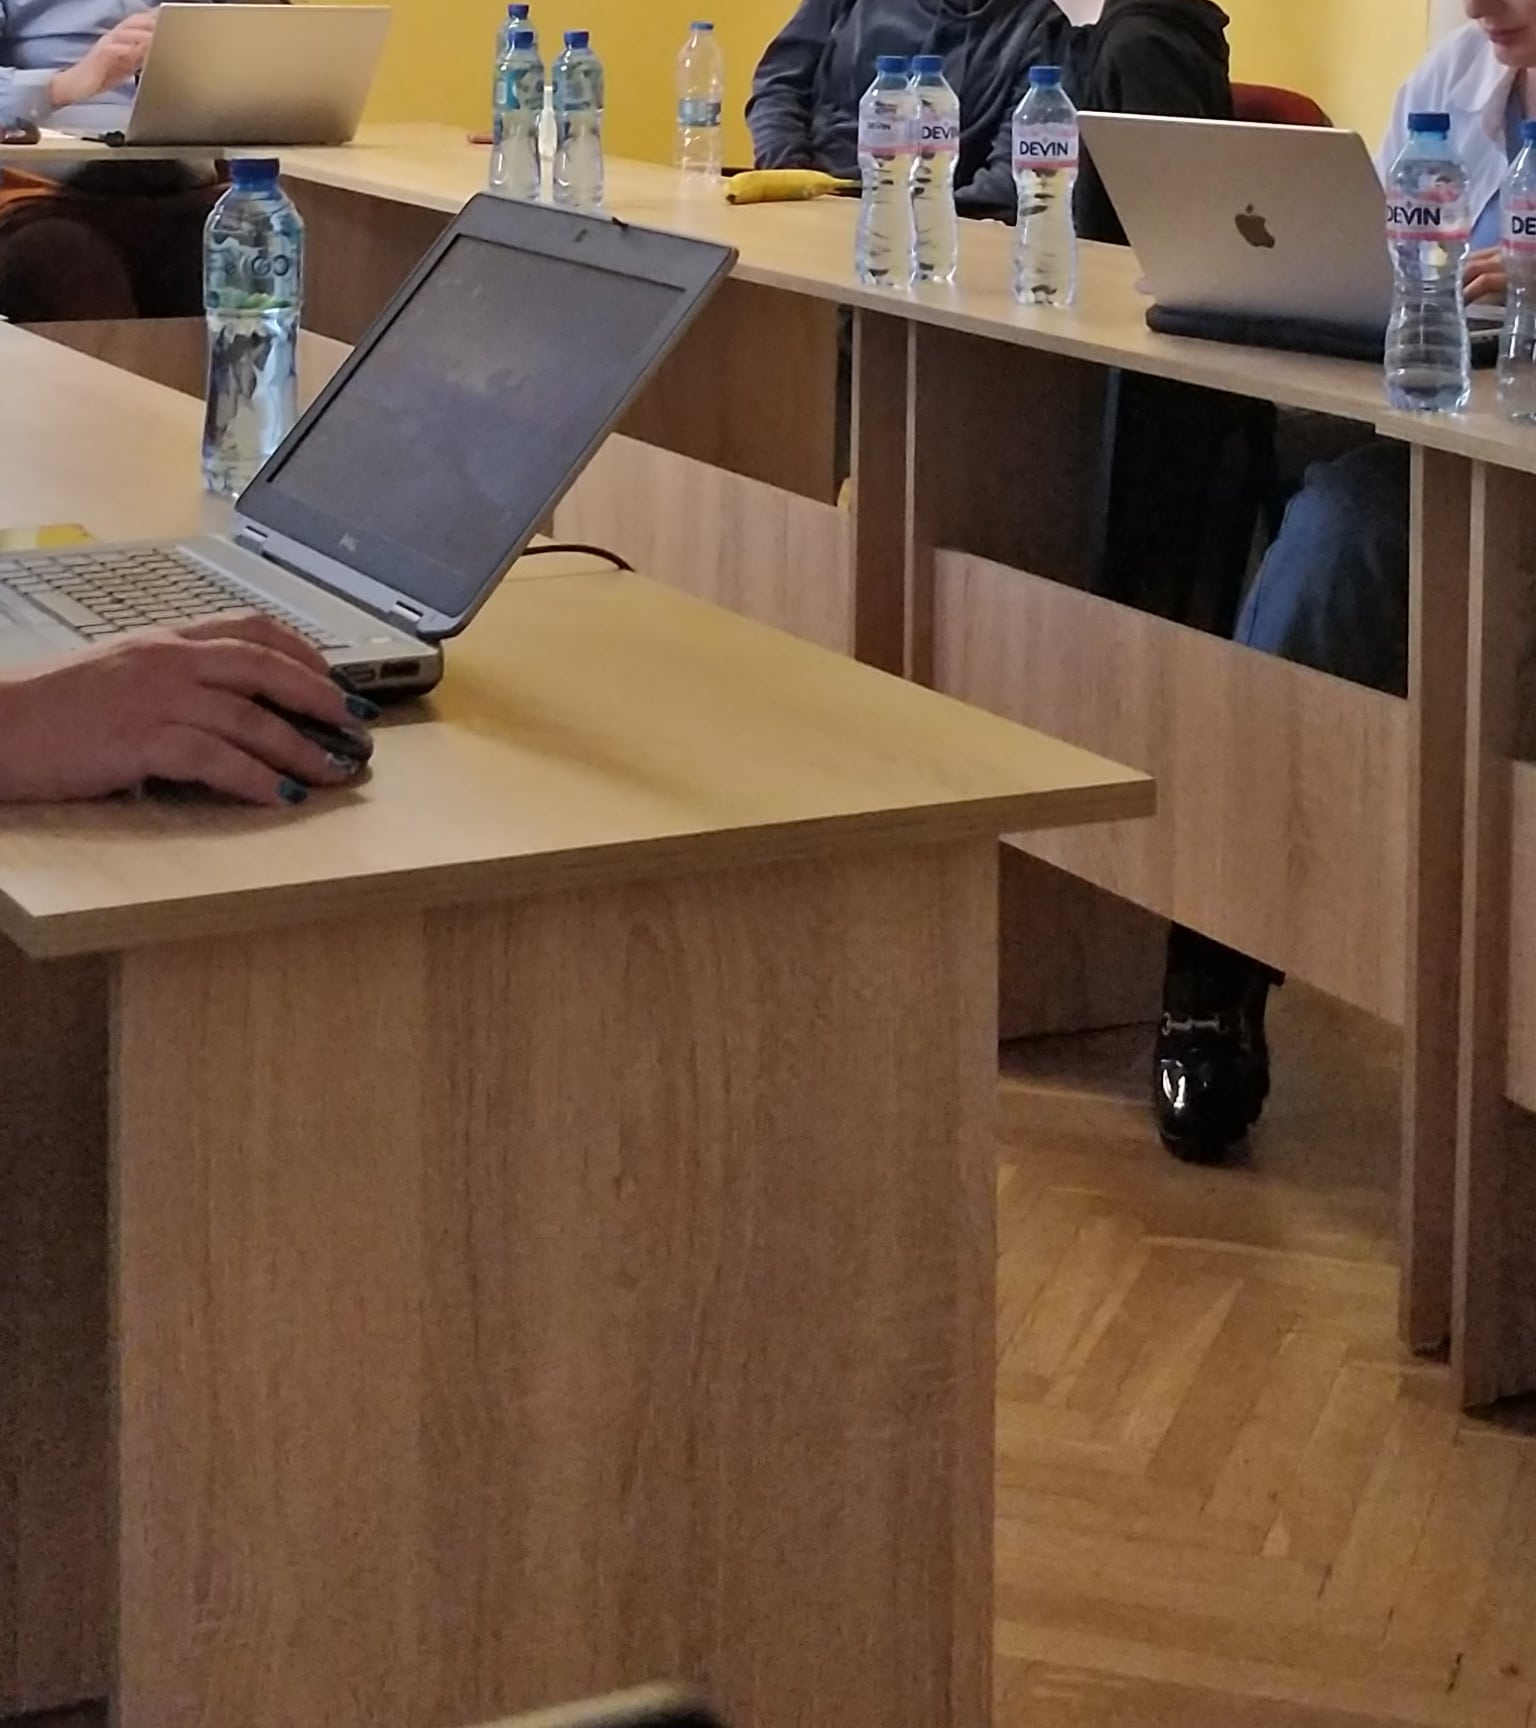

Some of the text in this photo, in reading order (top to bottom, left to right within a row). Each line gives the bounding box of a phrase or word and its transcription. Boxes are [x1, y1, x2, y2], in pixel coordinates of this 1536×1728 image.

[1019, 140, 1069, 157] DEVIN
[1386, 204, 1442, 227] DEVIN
[251, 254, 290, 277] GO
